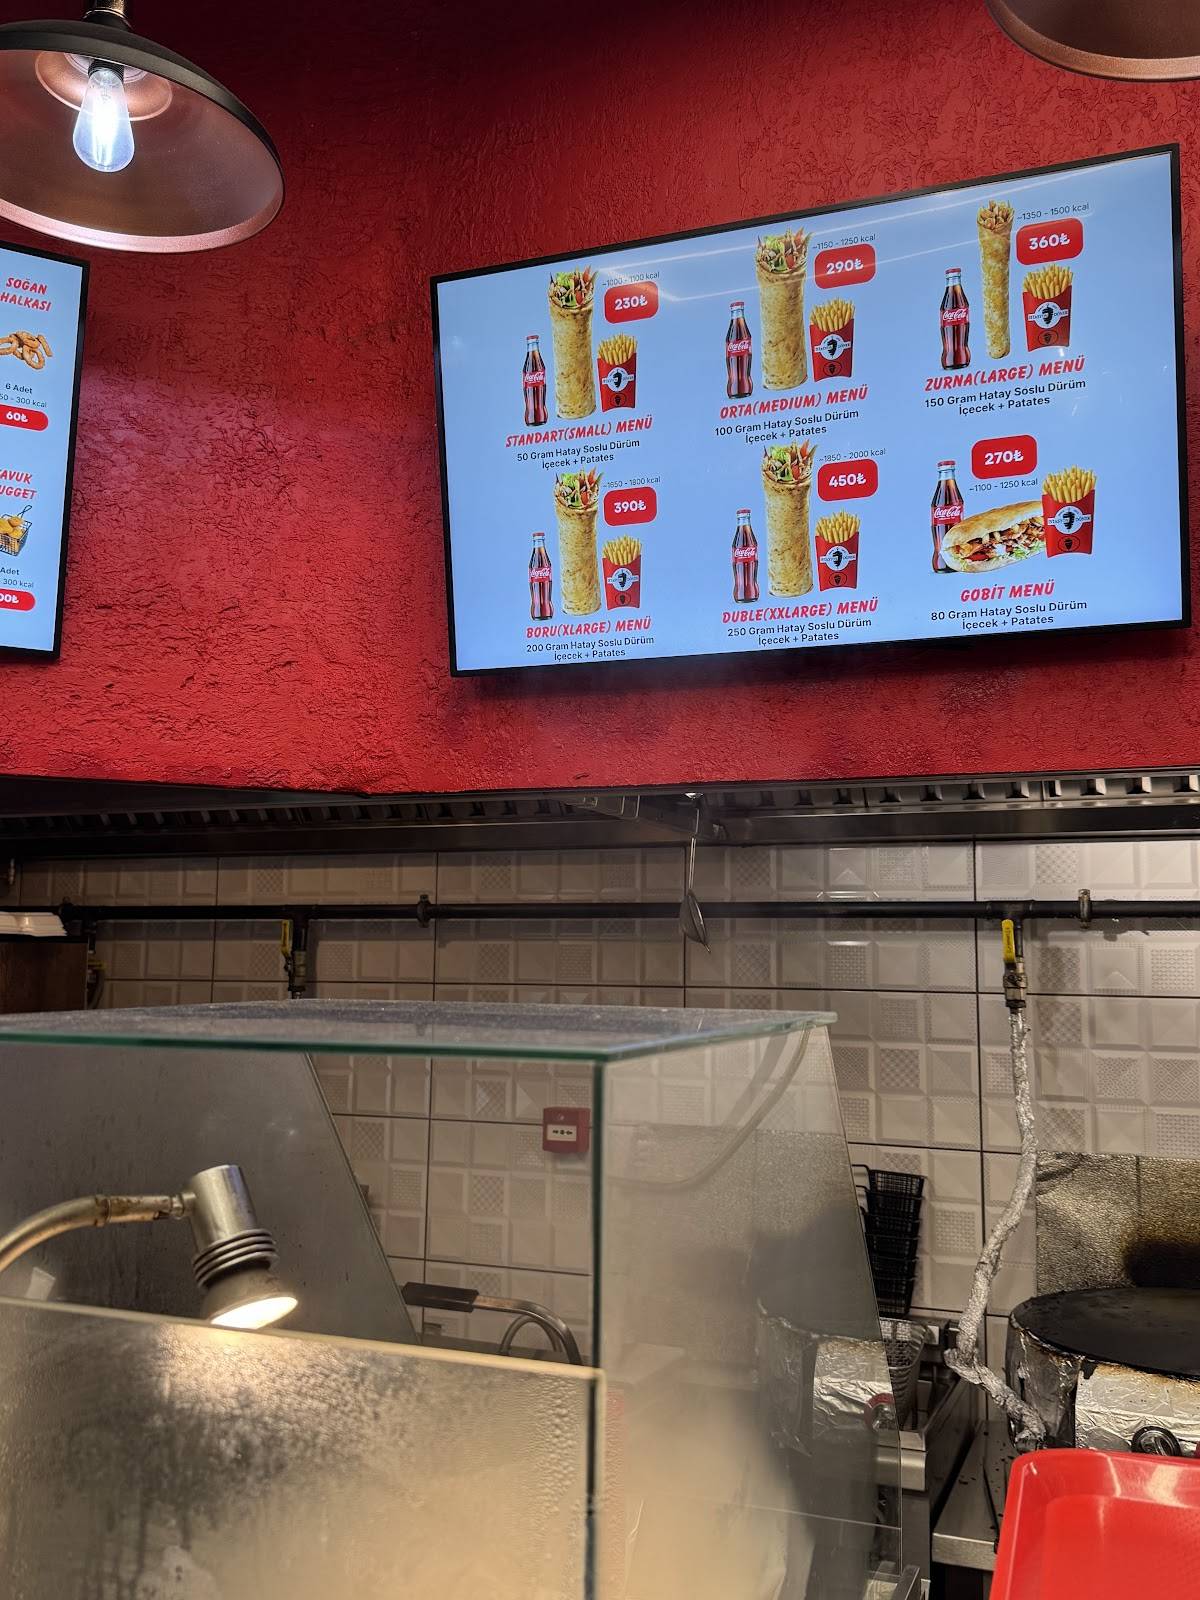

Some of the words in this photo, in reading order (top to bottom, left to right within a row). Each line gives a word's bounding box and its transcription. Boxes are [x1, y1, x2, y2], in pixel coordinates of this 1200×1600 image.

[1051, 206, 1070, 216] 1500
[1072, 203, 1089, 213] kcal
[841, 236, 858, 246] 1250
[860, 234, 876, 243] kcal
[6, 278, 47, 295] SOĞAN
[0, 292, 51, 311] HALKASI
[925, 365, 1034, 391] ZURNA(LARGE)
[1039, 355, 1085, 376] MENÜ
[12, 385, 32, 394] Adet
[925, 397, 944, 407] 150
[947, 394, 976, 405] Gram
[979, 389, 1011, 402] Hatay
[1015, 385, 1045, 396] Soslu
[1048, 379, 1086, 392] Dürüm
[32, 400, 46, 408] kcal
[720, 392, 821, 420] ORTA(MEDIUM)
[826, 384, 869, 405] MENÜ
[959, 401, 994, 416] İçecek
[1008, 396, 1050, 409] Patates
[505, 422, 612, 448] STANDART(SMALL)
[616, 414, 652, 433] MENÜ
[715, 427, 732, 436] 100
[735, 423, 761, 433] Gram
[764, 419, 792, 432] Hatay
[795, 415, 822, 426] Soslu
[825, 410, 859, 422] Dürüm
[745, 431, 777, 444] İçecek
[789, 426, 827, 437] Patates
[517, 453, 528, 461] 50
[530, 450, 554, 460] Gram
[556, 446, 581, 458] Hatay
[583, 442, 607, 453] Soslu
[610, 439, 640, 450] Dürüm
[850, 450, 868, 459] 2000
[871, 448, 885, 457] kcal
[542, 456, 570, 470] İçecek
[581, 453, 614, 464] Patates
[0, 470, 32, 484] AVUK
[647, 476, 660, 484] kcal
[1000, 480, 1020, 489] 1250
[1021, 478, 1038, 487] kcal
[0, 567, 20, 576] Adet
[1009, 579, 1055, 598] MENÜ
[722, 602, 832, 624] DUBLE(XXLARGE)
[837, 596, 879, 615] MENÜ
[931, 611, 945, 621] 80
[948, 610, 977, 620] Gram
[980, 606, 1011, 618] Hatay
[1015, 604, 1046, 615] Soslu
[1049, 600, 1087, 612] Dürüm
[526, 620, 611, 638] BORU(XLARGE)
[616, 616, 651, 632] MENÜ
[728, 627, 746, 637] 250
[749, 625, 775, 635] Gram
[777, 622, 805, 634] Hatay
[808, 621, 835, 632] Soslu
[838, 617, 872, 628] Dürüm
[962, 618, 998, 630] İçecek
[1011, 615, 1054, 626] Patates
[527, 644, 543, 652] 200
[546, 641, 568, 651] Gram
[571, 637, 596, 649] Hatay
[598, 636, 622, 647] Soslu
[625, 636, 654, 645] Dürüm
[758, 635, 790, 647] İçecek
[802, 631, 839, 642] Patates
[554, 650, 582, 661] İçecek
[593, 648, 626, 658] Patates
